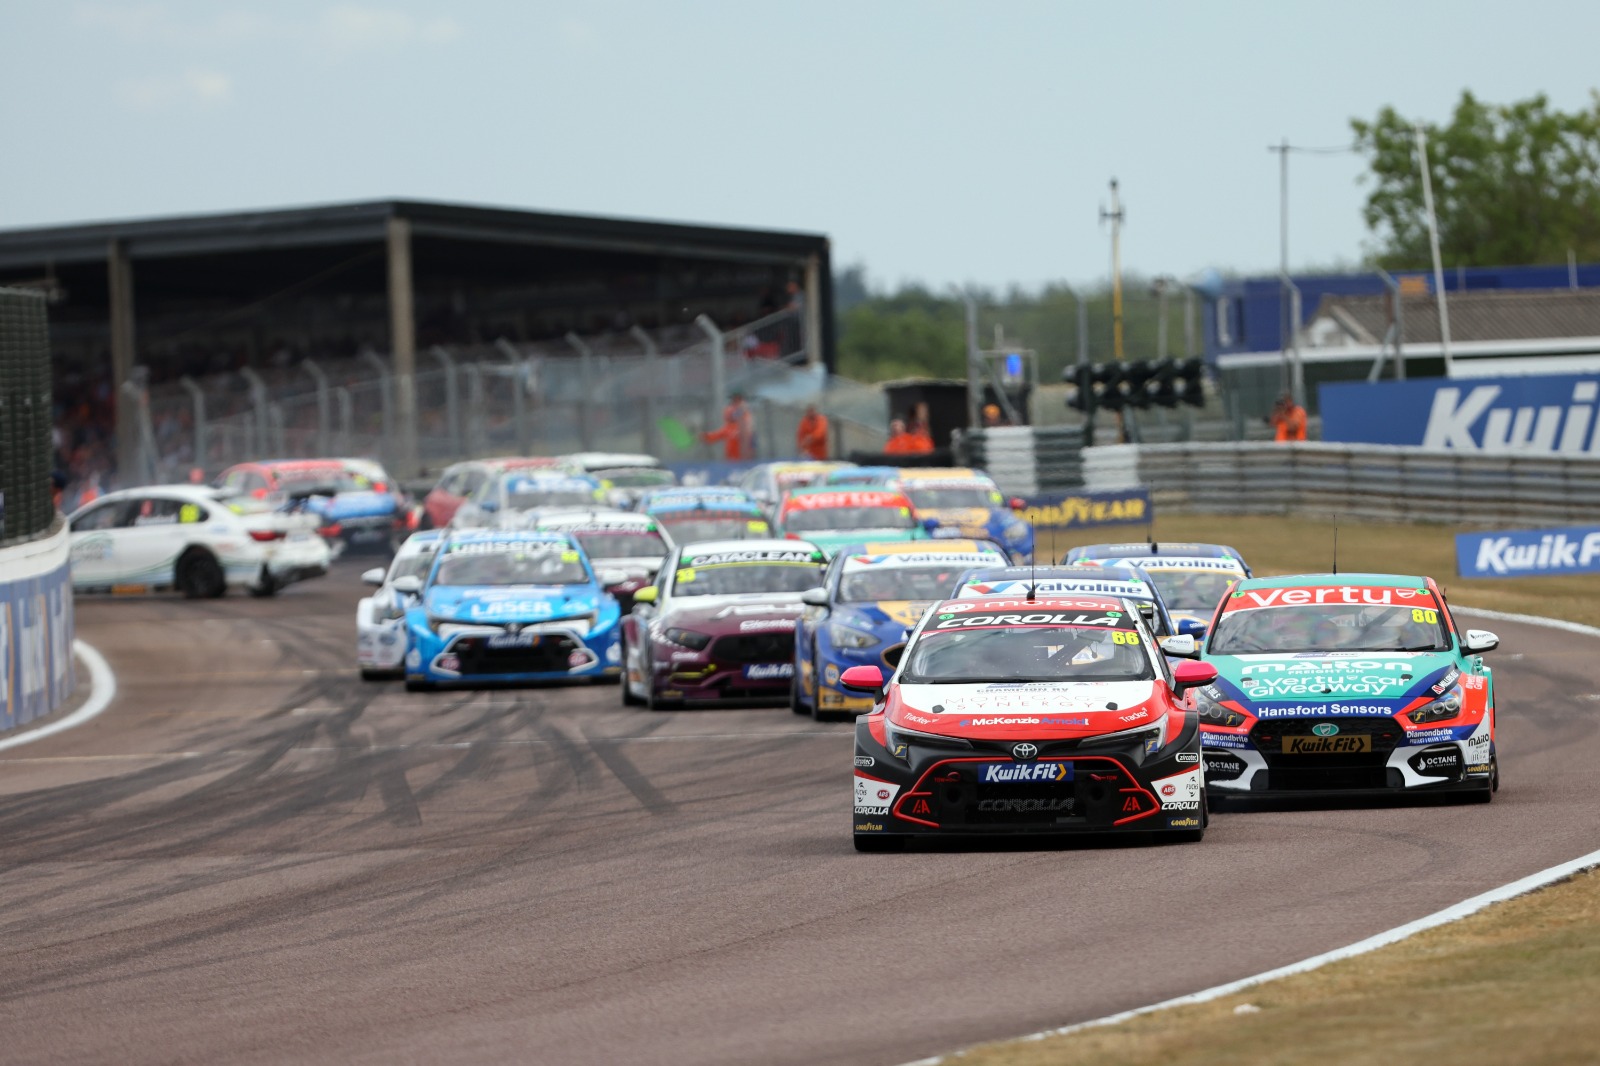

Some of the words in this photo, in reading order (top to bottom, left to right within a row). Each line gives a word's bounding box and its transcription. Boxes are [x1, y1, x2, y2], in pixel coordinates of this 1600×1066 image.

[1421, 381, 1600, 451] Kwi
[691, 551, 812, 566] CATACLEAN
[897, 554, 996, 562] Valvoline
[1128, 558, 1235, 570] Valvoline
[1022, 582, 1142, 594] Valvoline
[985, 599, 1120, 611] morson
[937, 614, 1120, 629] COROLLA
[1412, 609, 1438, 625] 80
[1112, 631, 1140, 646] 66
[957, 701, 1095, 710] SYNERGY
[1258, 704, 1327, 718] Hansford
[1330, 703, 1393, 715] Sensors
[904, 712, 932, 725] Tracker
[1119, 709, 1149, 722] Tracker
[1202, 731, 1249, 743] Diamondbrite
[1406, 728, 1453, 739] Diamondbrite
[1209, 761, 1240, 770] OCTANE
[1427, 755, 1457, 765] OCTANE
[854, 806, 890, 815] COROLLA
[1161, 801, 1199, 811] COROLLA
[1171, 817, 1199, 827] GOODYEAR
